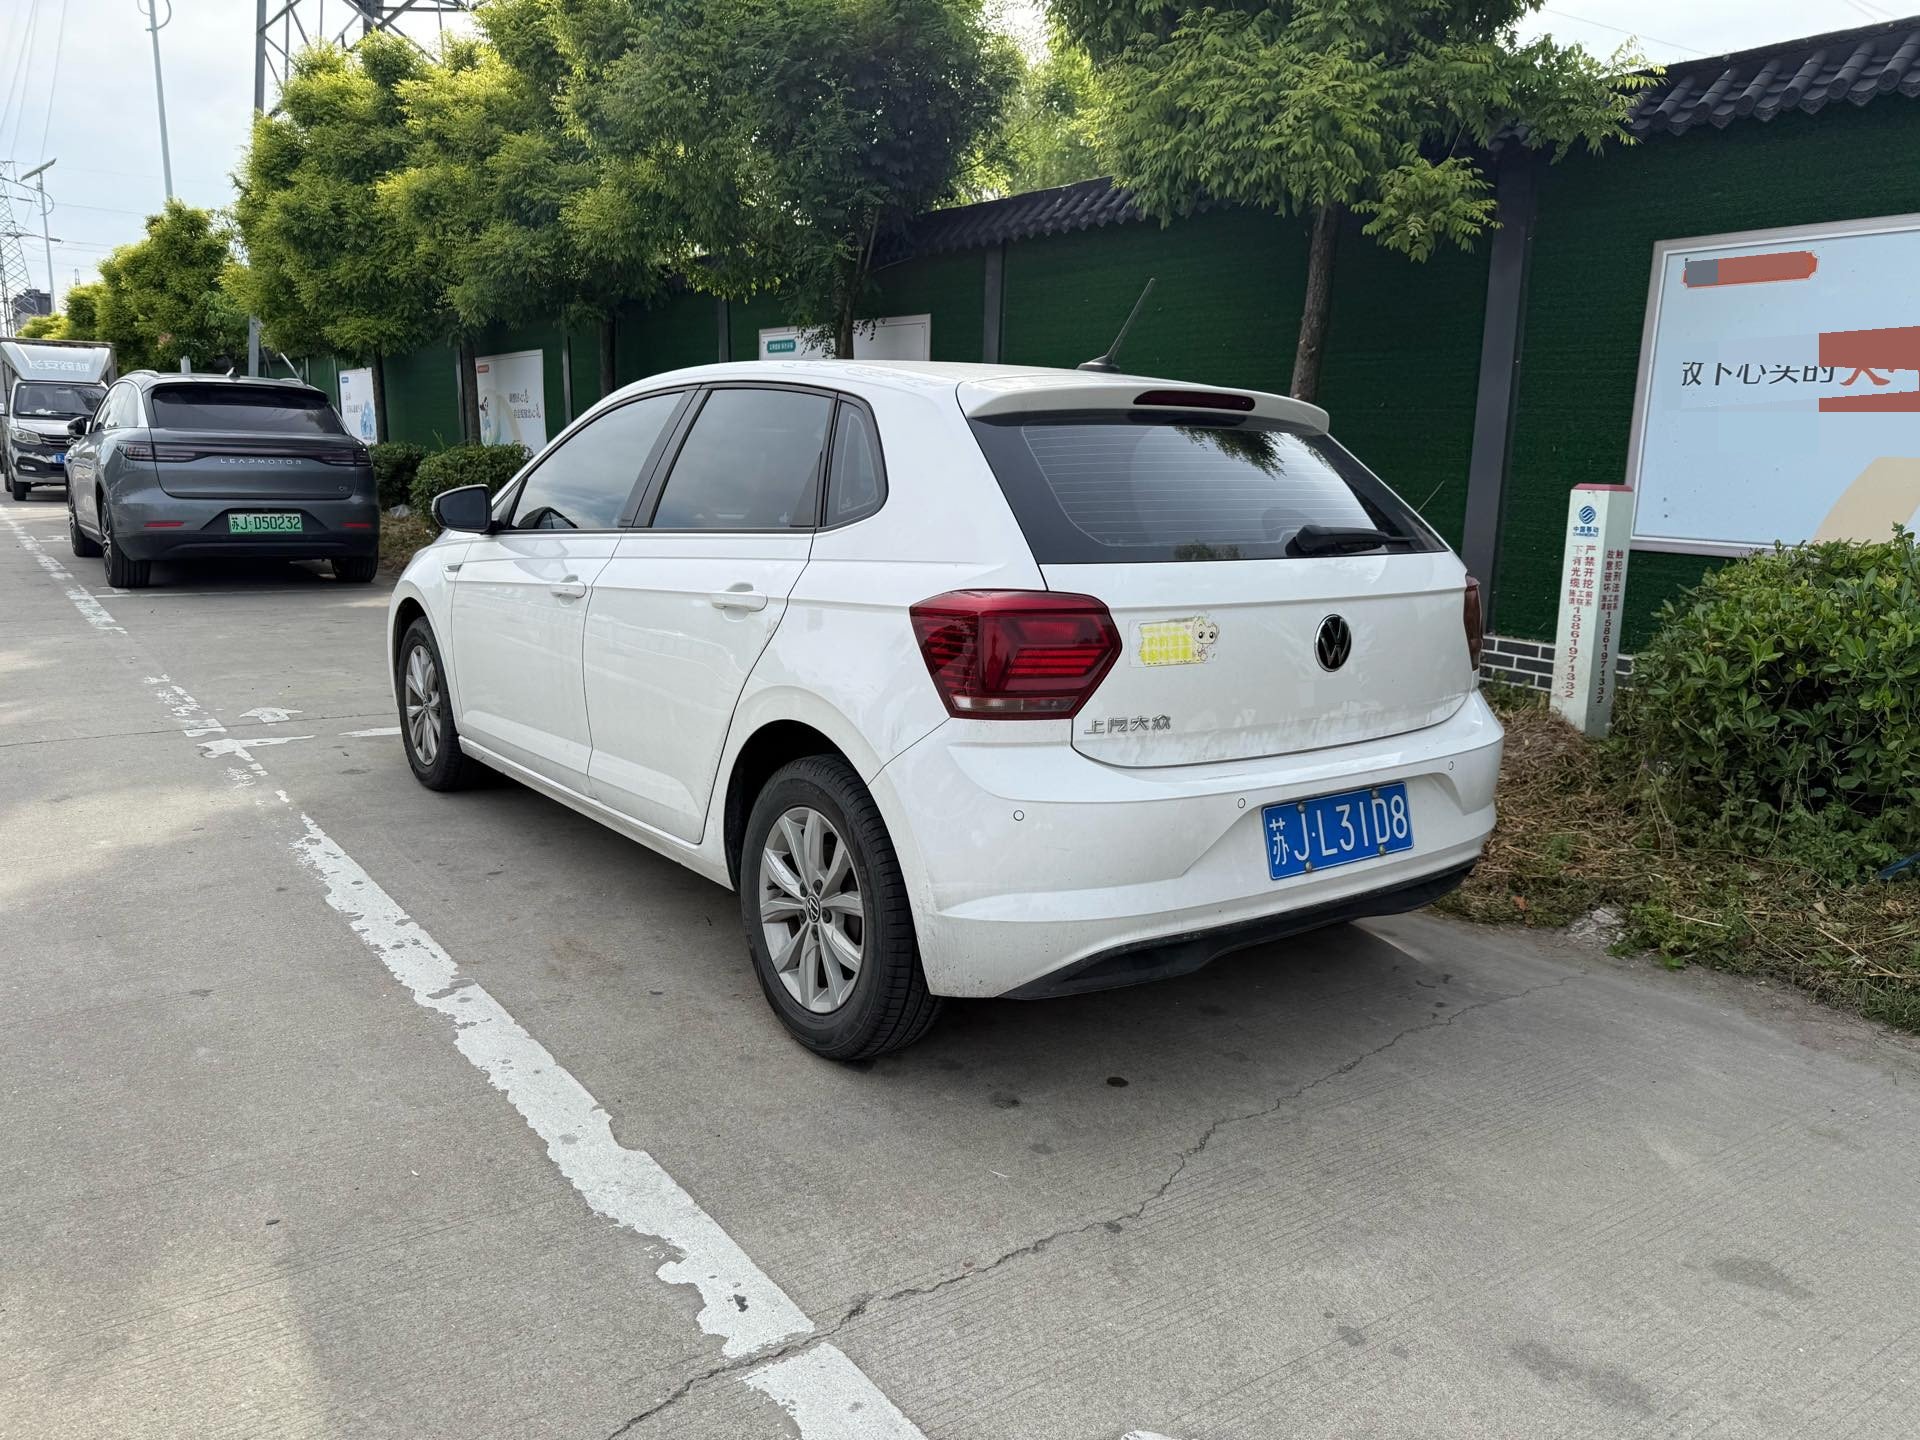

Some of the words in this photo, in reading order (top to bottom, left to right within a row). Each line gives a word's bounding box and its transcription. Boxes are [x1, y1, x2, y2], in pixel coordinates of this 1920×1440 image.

[1583, 545, 1596, 589] 严禁开挖
[1565, 606, 1581, 698] 15861971332
[1597, 612, 1611, 704] 15861971332
